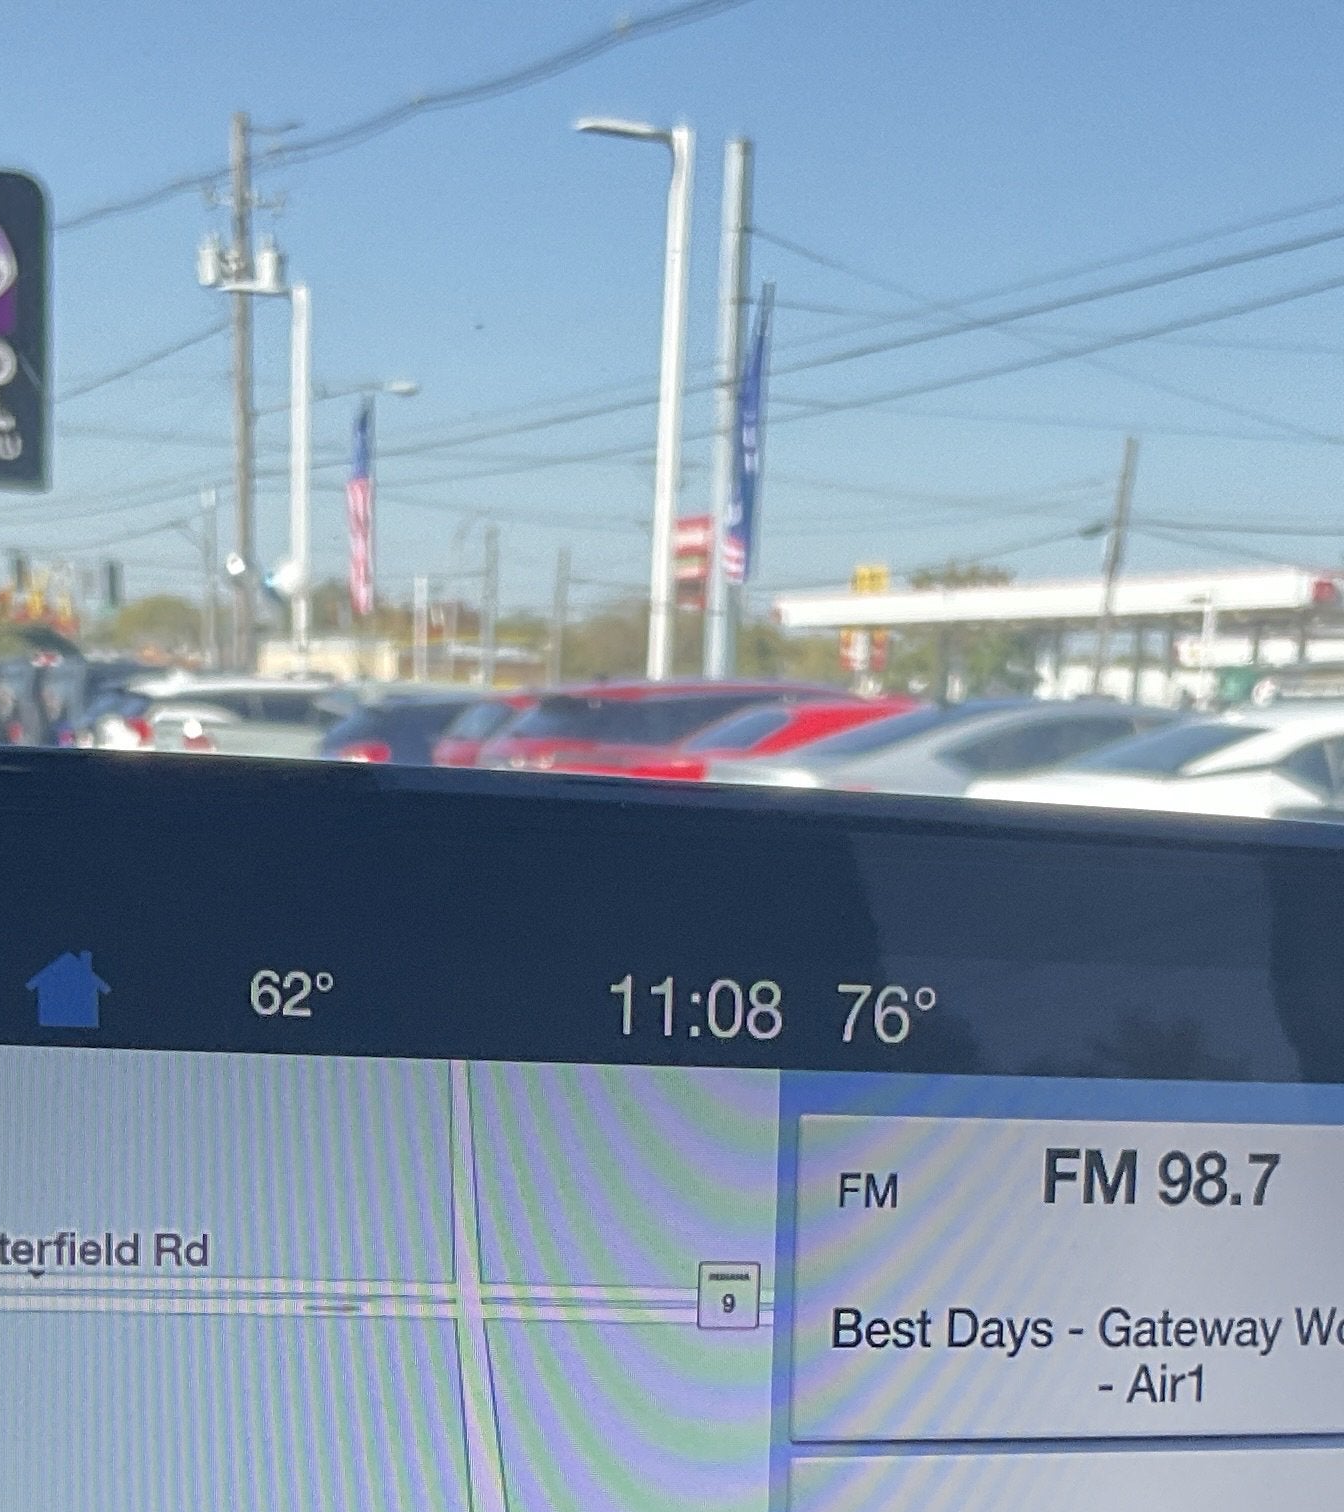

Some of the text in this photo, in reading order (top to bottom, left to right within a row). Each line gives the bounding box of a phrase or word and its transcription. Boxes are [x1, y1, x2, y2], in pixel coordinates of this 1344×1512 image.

[250, 969, 334, 1017] 62°
[610, 974, 783, 1040] 11:08
[837, 984, 936, 1043] 76°
[839, 1172, 898, 1208] FM
[1044, 1148, 1280, 1206] FM 98.7
[155, 1233, 208, 1267] Rd
[722, 1293, 736, 1314] 9
[832, 1308, 932, 1349] Best
[947, 1308, 1053, 1358] Days
[1099, 1307, 1283, 1356] Gateway
[1126, 1363, 1203, 1403] Air1
